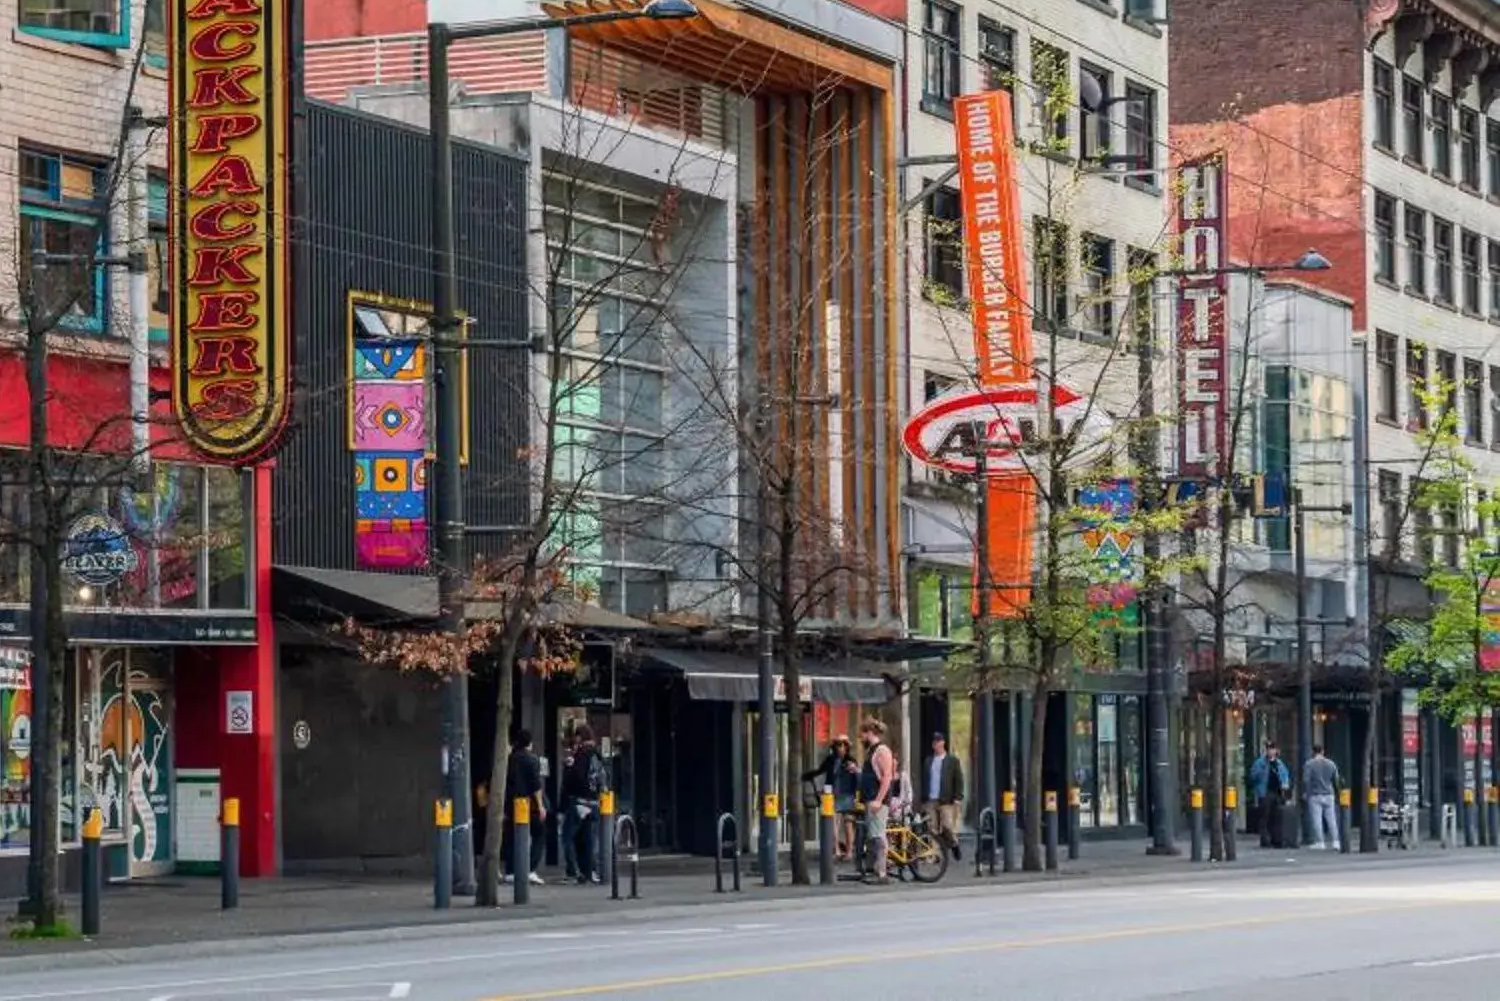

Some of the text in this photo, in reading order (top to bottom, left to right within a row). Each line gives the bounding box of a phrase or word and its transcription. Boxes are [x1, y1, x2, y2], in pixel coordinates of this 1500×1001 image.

[967, 101, 1014, 379] HOME OF THE BURGER FAMILY
[1183, 166, 1221, 464] HOTEL
